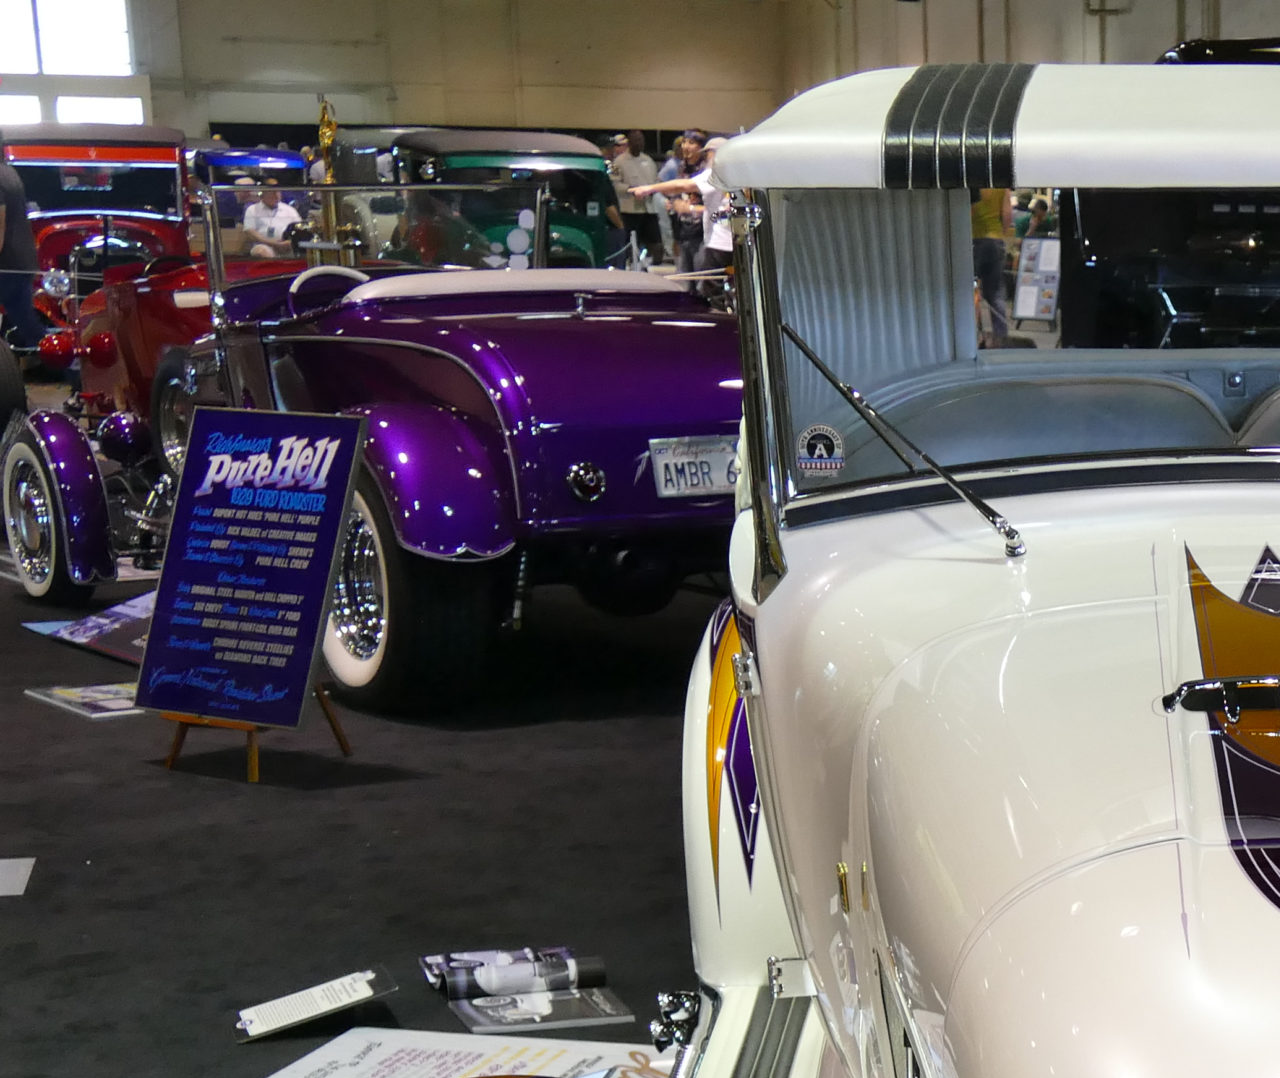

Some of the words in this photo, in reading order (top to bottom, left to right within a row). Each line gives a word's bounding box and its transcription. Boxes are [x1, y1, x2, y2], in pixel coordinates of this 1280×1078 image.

[813, 444, 829, 458] A
[194, 452, 273, 498] Pure
[263, 435, 341, 491] Hell
[663, 460, 713, 489] AMBR
[254, 488, 280, 508] FORD
[278, 490, 327, 512] ROADSTER
